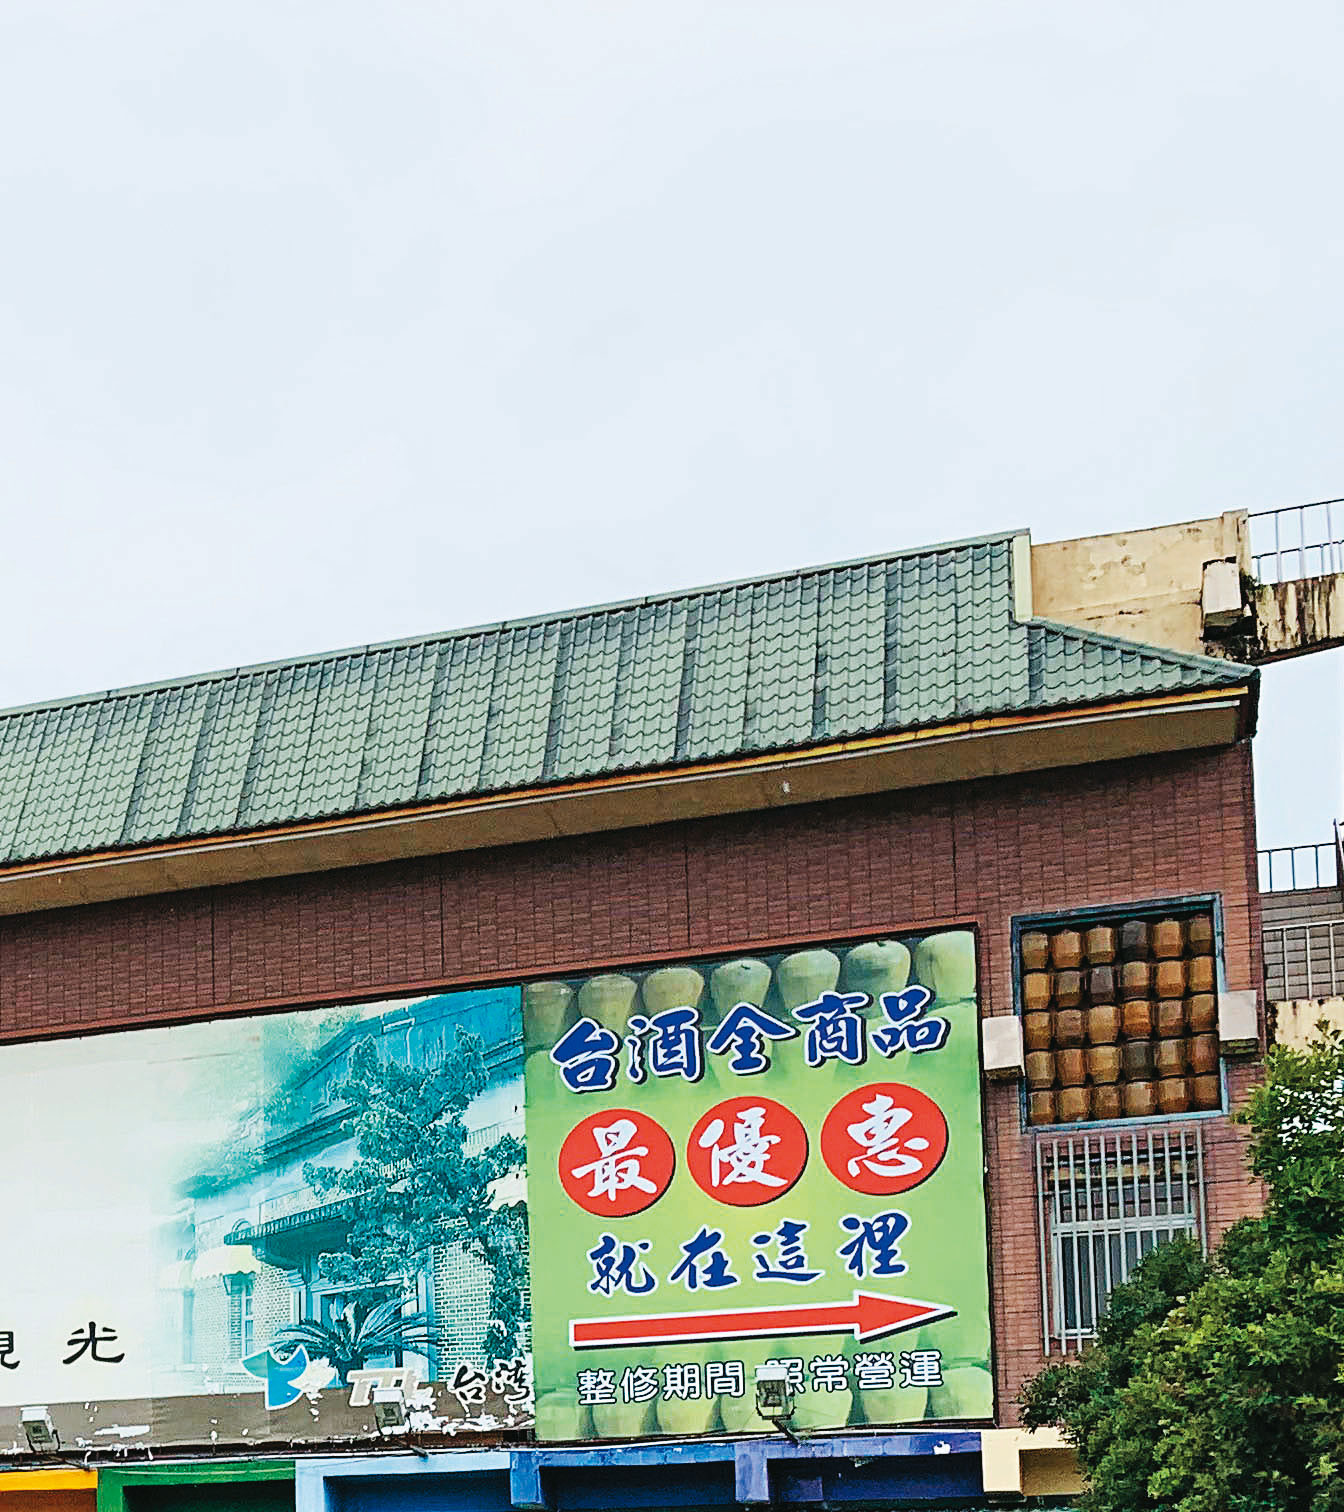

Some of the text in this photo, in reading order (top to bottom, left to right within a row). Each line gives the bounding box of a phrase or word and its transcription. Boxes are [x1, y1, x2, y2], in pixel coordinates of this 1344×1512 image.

[552, 984, 952, 1094] 台酒全商品
[569, 1090, 934, 1205] 最優惠
[576, 1361, 745, 1406] 整修期間
